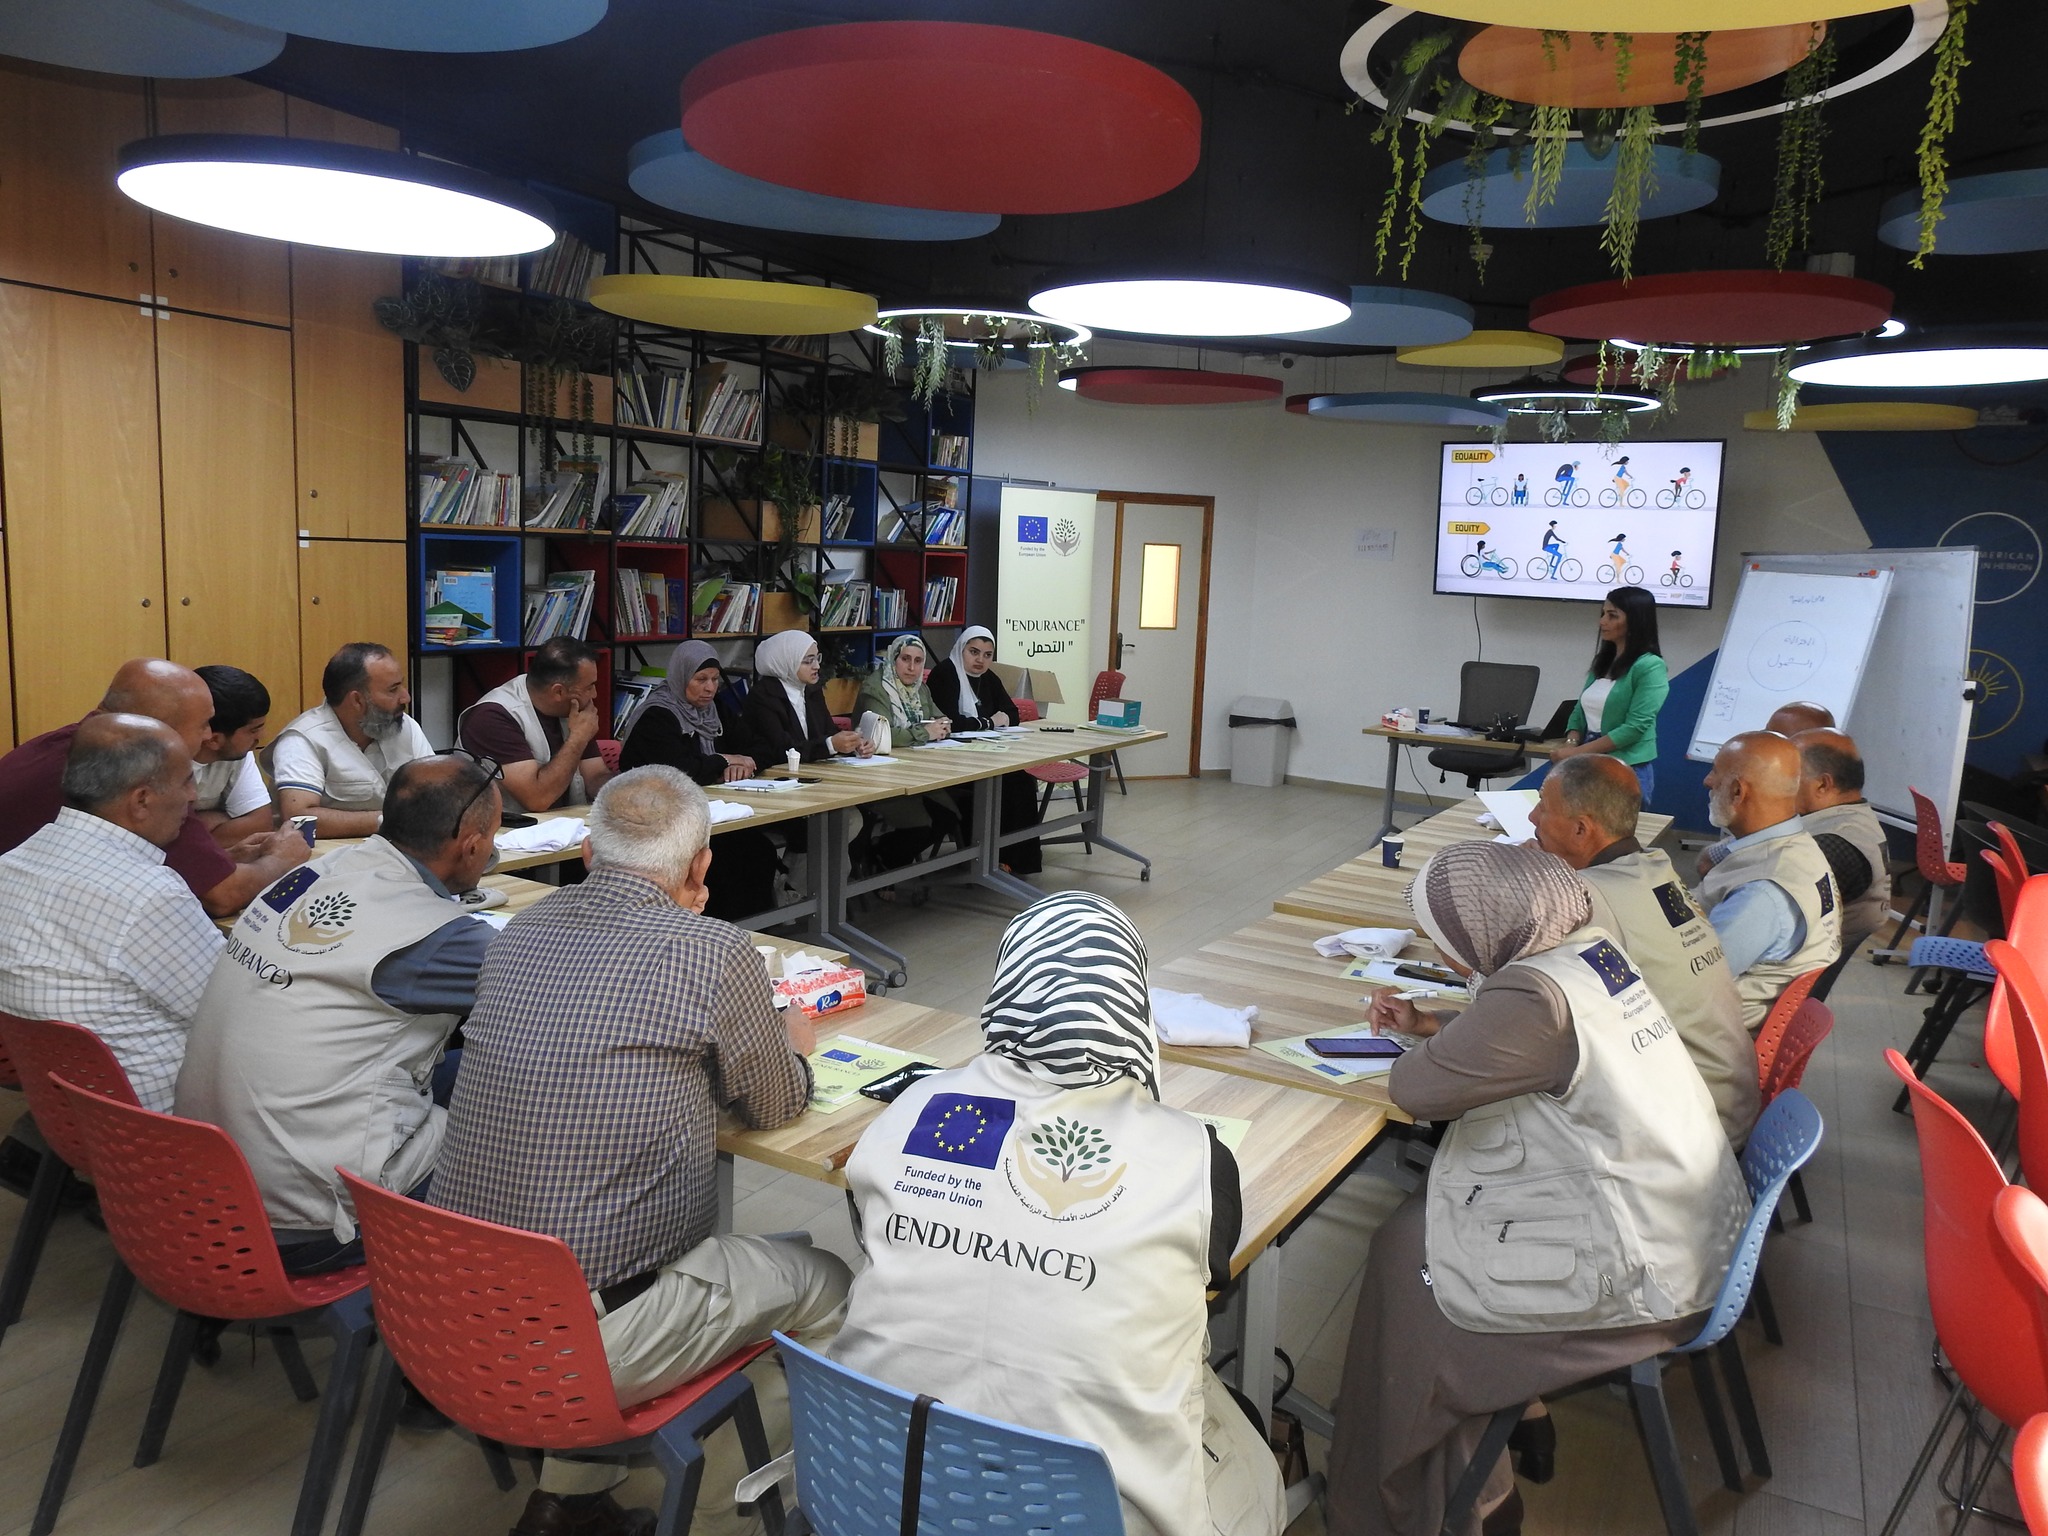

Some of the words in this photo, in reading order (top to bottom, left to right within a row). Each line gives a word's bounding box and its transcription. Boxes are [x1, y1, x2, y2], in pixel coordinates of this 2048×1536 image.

[1454, 452, 1488, 461] EQUALITY
[1455, 524, 1480, 532] EQUITY
[1980, 551, 2034, 561] MERICAN
[904, 1165, 946, 1183] Funded
[947, 1174, 962, 1189] by
[964, 1178, 982, 1191] the
[893, 1180, 946, 1200] European
[949, 1191, 983, 1208] Union
[885, 1211, 1097, 1292] (ENDURANCE)
